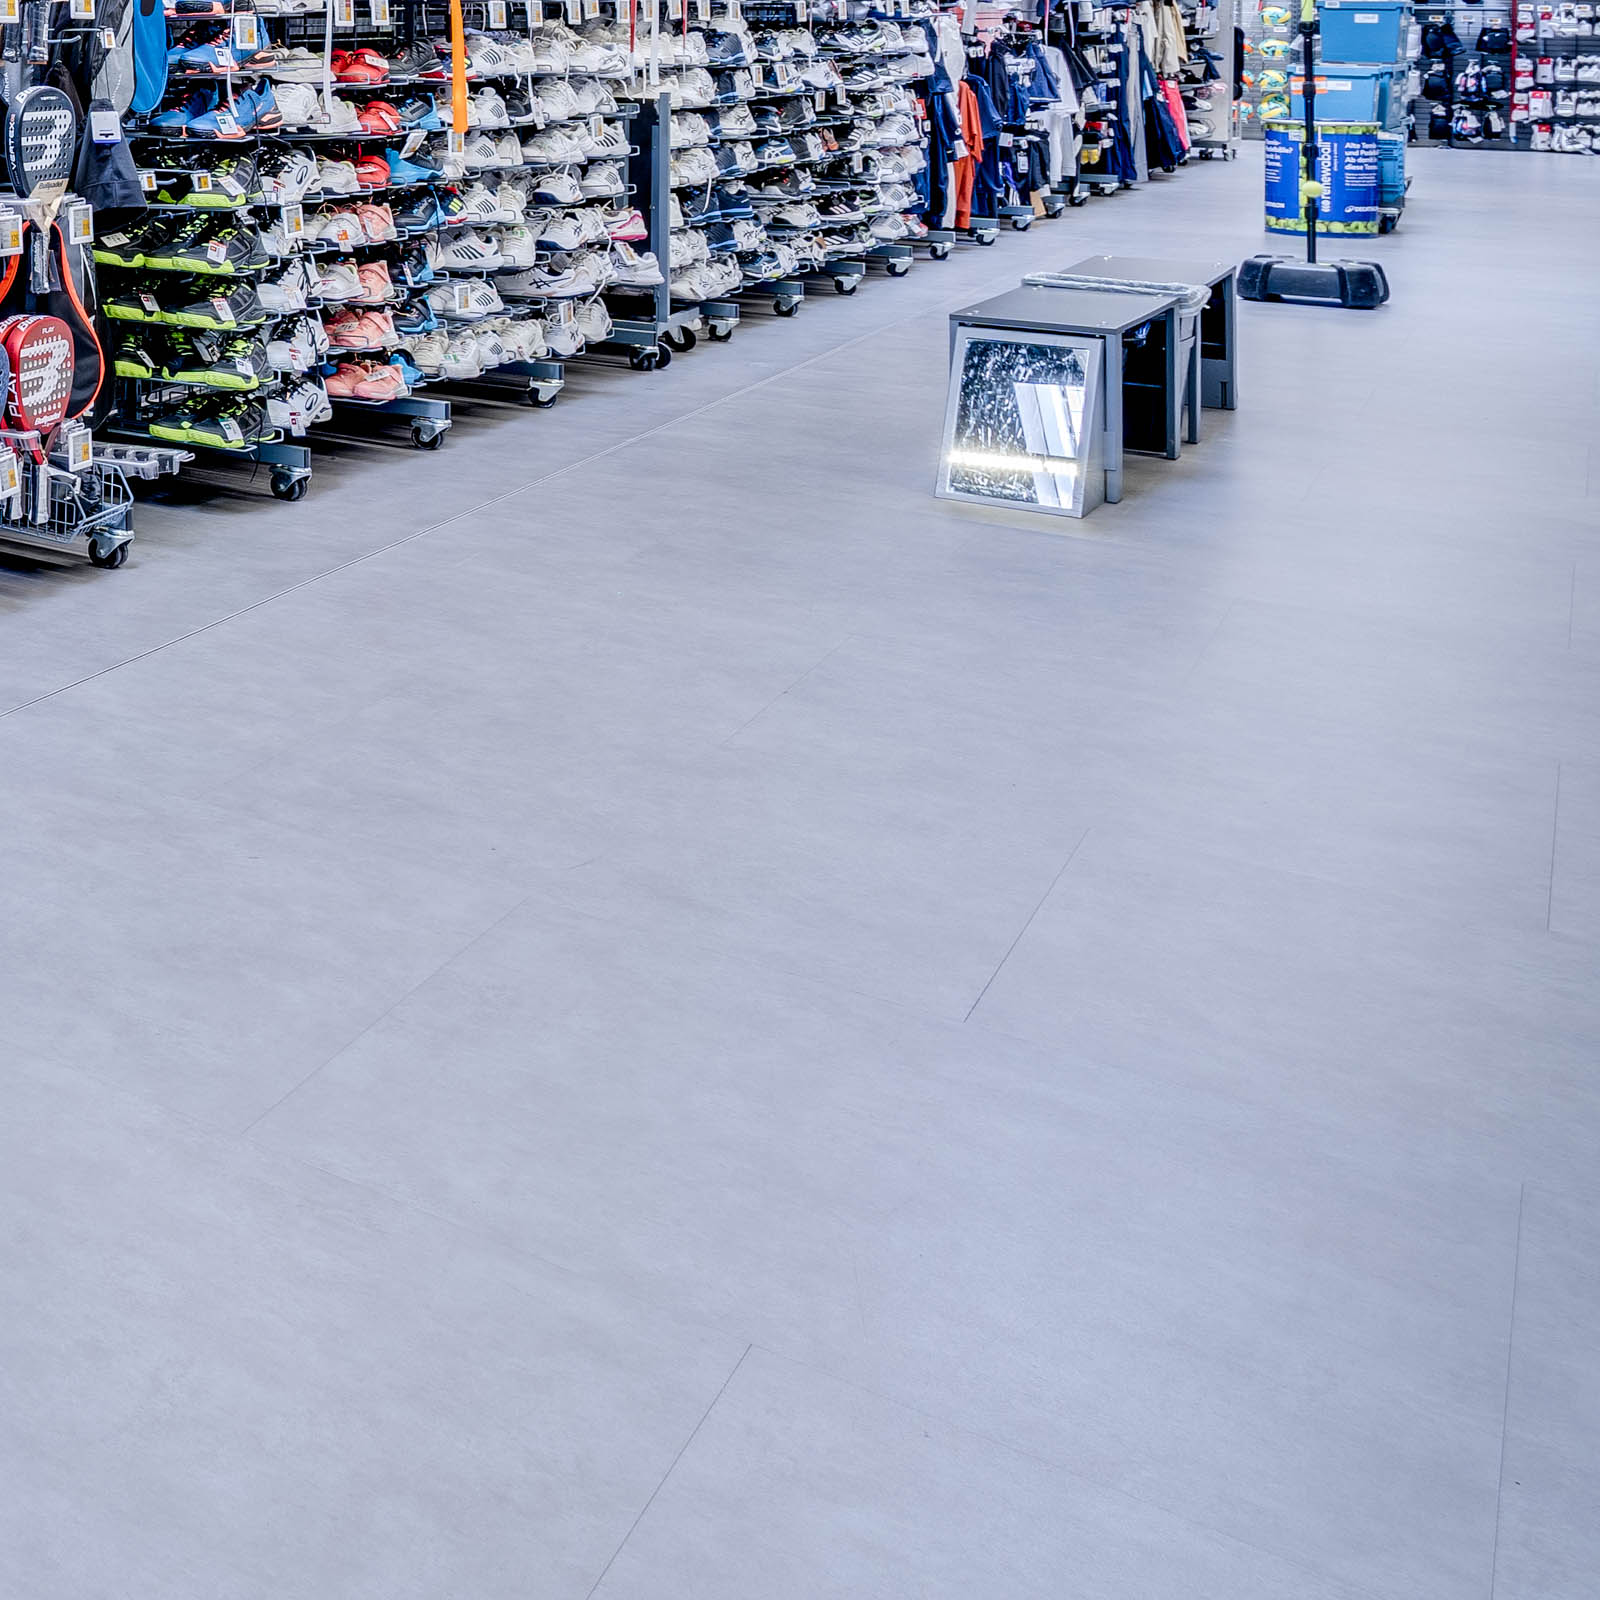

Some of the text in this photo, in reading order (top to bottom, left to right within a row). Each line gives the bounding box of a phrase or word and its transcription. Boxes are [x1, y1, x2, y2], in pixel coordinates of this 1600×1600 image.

[9, 121, 17, 171] VERTEX
[39, 181, 64, 189] Bullpadel
[41, 326, 55, 334] PLAY
[7, 370, 22, 418] PLAY
[34, 411, 61, 426] Bullpadel
